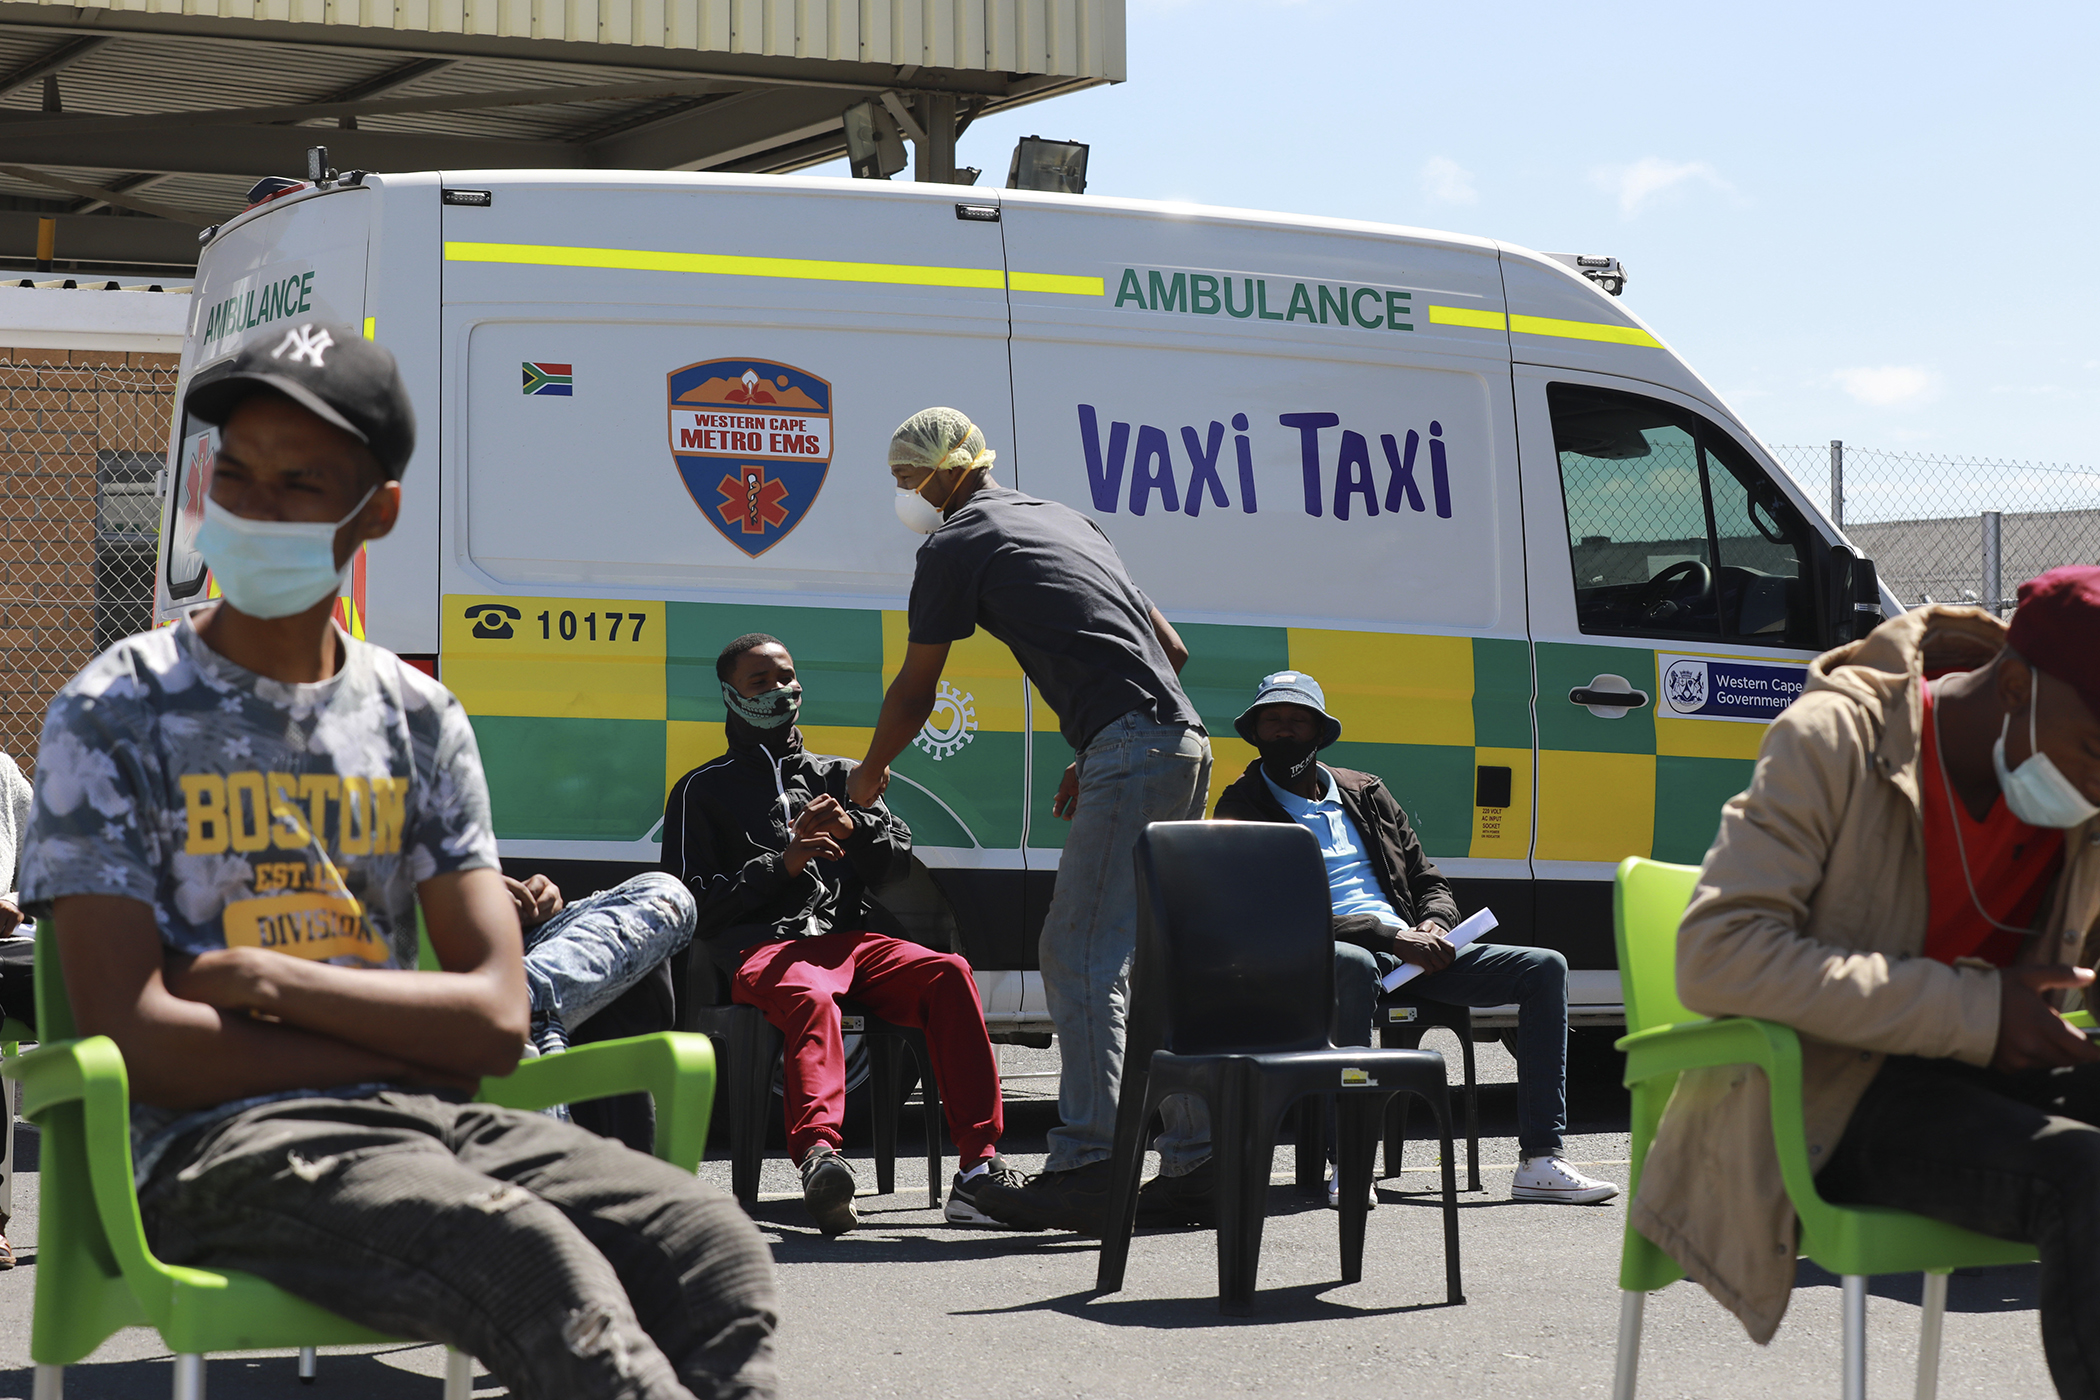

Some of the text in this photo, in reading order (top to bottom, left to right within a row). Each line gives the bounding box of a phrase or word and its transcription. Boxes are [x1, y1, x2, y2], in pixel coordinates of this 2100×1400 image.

[203, 270, 315, 346] AMBULANCE
[1114, 268, 1414, 331] AMBULANCE
[270, 323, 335, 368] NY
[694, 413, 807, 432] WESTERN CAPE
[680, 428, 820, 455] METRO EMS
[537, 610, 646, 642] 10177
[1715, 674, 1803, 694] Western Cape
[1716, 691, 1792, 708] Government
[179, 770, 409, 855] BOSTON
[256, 908, 373, 947] DIVISION
